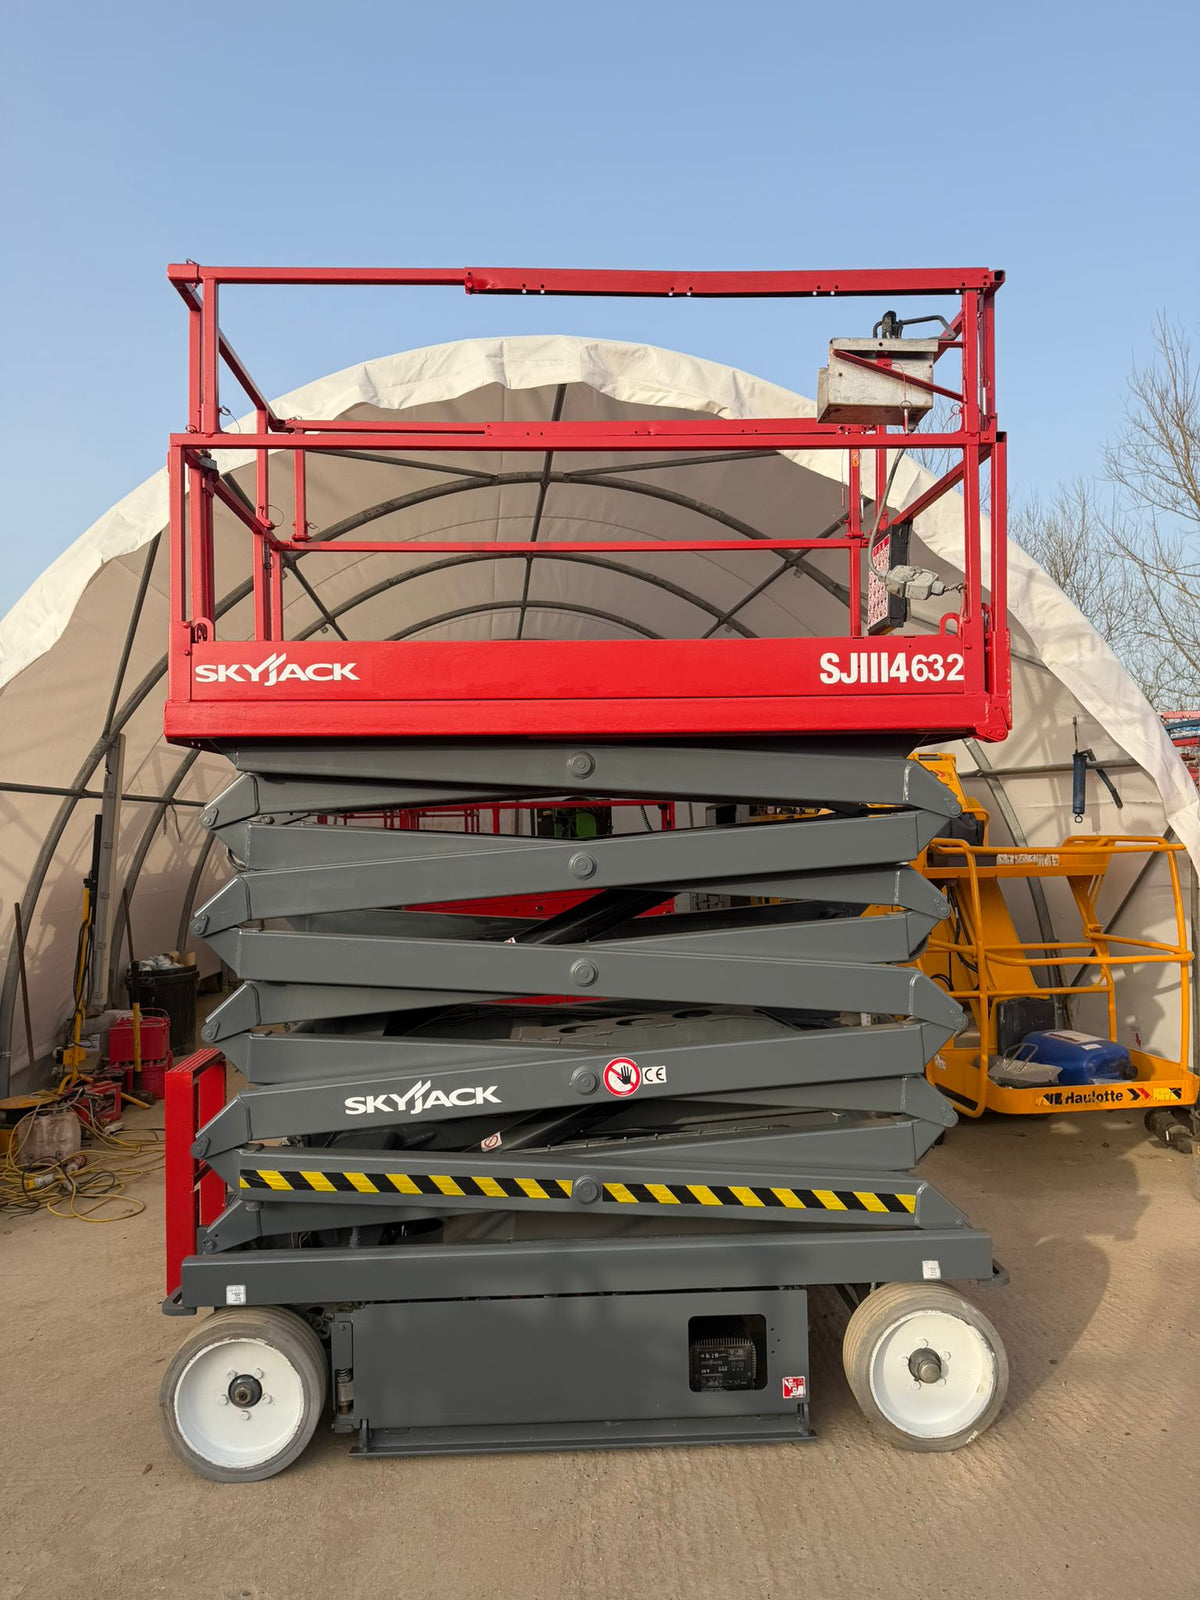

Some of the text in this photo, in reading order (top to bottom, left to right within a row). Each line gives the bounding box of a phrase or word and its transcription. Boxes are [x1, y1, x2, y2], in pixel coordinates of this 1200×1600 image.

[194, 652, 360, 686] SKYJACK
[644, 1067, 665, 1082] CE
[344, 1080, 502, 1115] SKYJACK
